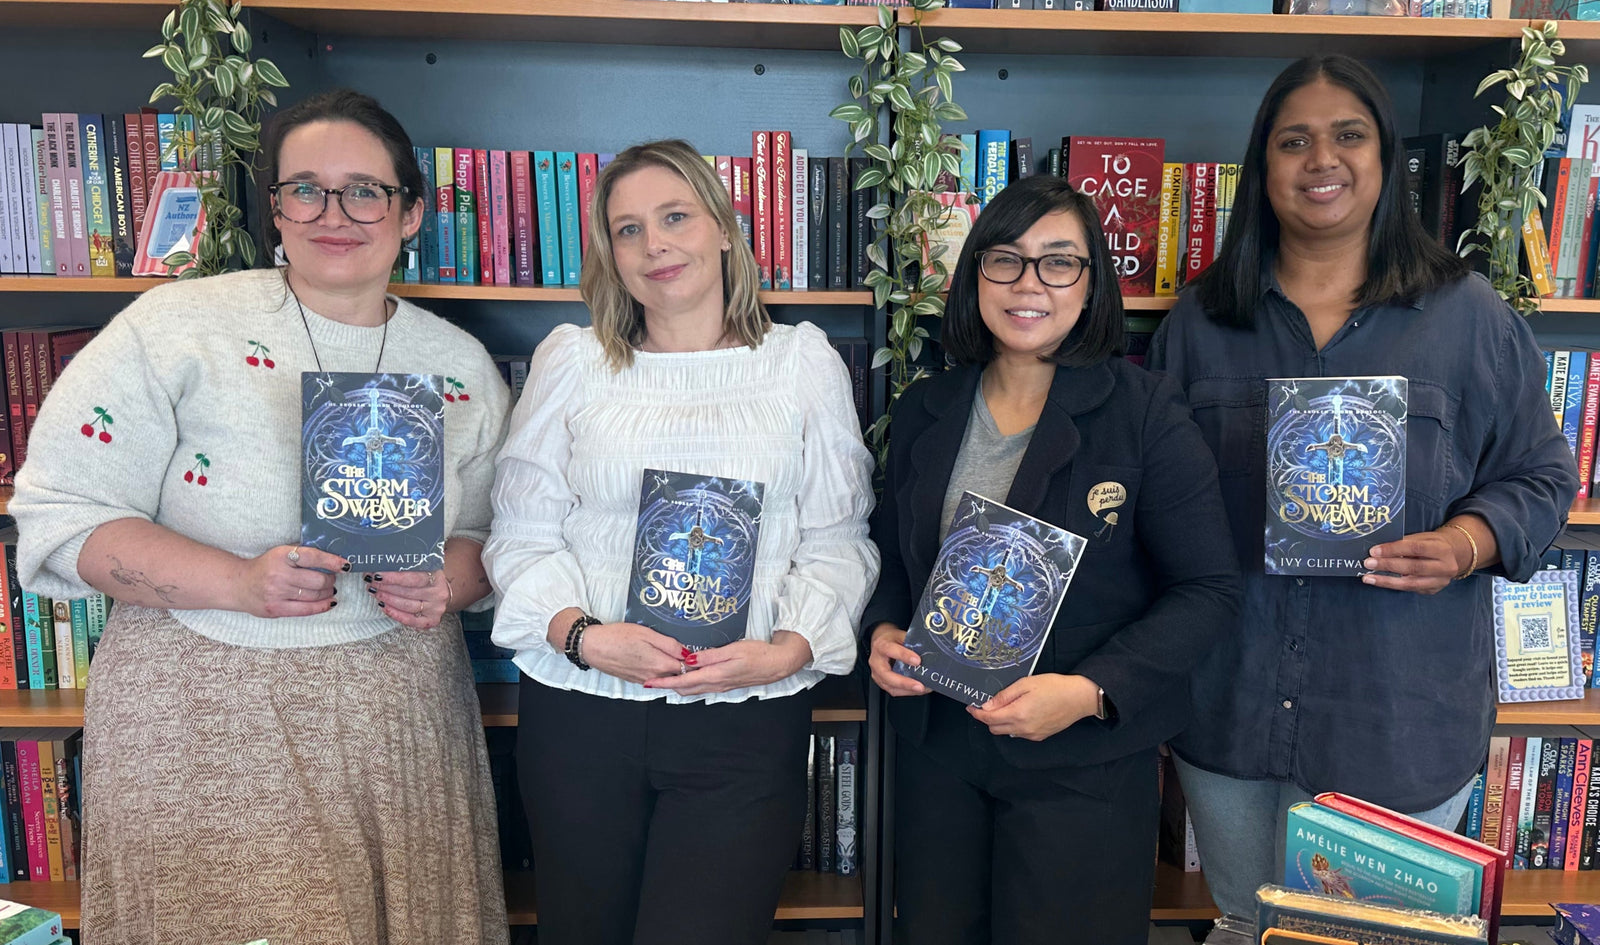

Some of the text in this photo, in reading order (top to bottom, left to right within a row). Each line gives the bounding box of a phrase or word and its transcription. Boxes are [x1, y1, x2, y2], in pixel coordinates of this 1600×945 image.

[144, 124, 158, 174] THE OTHER
[756, 133, 767, 155] Fast
[777, 133, 786, 155] Fast
[987, 141, 998, 175] FERAL
[998, 141, 1007, 160] THE
[1447, 140, 1456, 167] WARS
[36, 139, 48, 195] Wonderland
[86, 124, 104, 225] CATHERINE CHIDGEY
[128, 124, 144, 223] THE OTHER CATHERINE
[457, 154, 470, 192] Happy
[1101, 154, 1131, 175] TO
[47, 122, 65, 239] THE BLACK MONK CHARLOTTE GRIMSHAW
[65, 122, 83, 239] THE BLACK MONK CHARLOTTE GRIMSHAW
[114, 167, 125, 212] AMERICAN
[439, 153, 451, 224] Book Lovers
[542, 173, 550, 200] Between
[796, 156, 805, 223] ADDICTED TO YOU
[1080, 177, 1148, 198] CAGE
[178, 204, 190, 212] NZ
[460, 195, 470, 225] Place
[517, 194, 526, 214] LEAGUE
[1104, 203, 1121, 226] A
[1190, 166, 1206, 270] DEATH'S END
[118, 214, 127, 236] BOYS
[1158, 168, 1173, 270] THE DARK FOREST
[1104, 233, 1141, 251] ILD
[1552, 356, 1567, 413] KATE ATKINSON
[1566, 374, 1580, 409] SILVA
[1580, 358, 1600, 483] JANET EVANOVICH KING'S RANSOM
[338, 465, 366, 478] THE
[1300, 471, 1326, 484] THE
[1091, 485, 1120, 500] je suis
[1099, 494, 1124, 508] perdu
[347, 554, 429, 565] CLIFFWATER
[662, 558, 686, 571] THE
[1280, 558, 1363, 569] IVY CLIFFWA
[957, 589, 980, 607] THE
[1503, 593, 1528, 601] story
[1530, 592, 1538, 600] &
[1514, 584, 1534, 594] part
[95, 594, 103, 614] DEEP
[1522, 600, 1552, 608] review
[1581, 598, 1592, 632] TEMPEST
[1588, 594, 1599, 635] QUANTUM
[74, 602, 86, 669] Heather Morris
[5, 637, 13, 670] RACHEL
[31, 648, 40, 676] DINNER
[930, 672, 994, 702] CLIFFWATE
[1558, 745, 1568, 775] SPARKS
[1567, 742, 1576, 777] NICHOLAS
[31, 762, 39, 791] SHEILA
[841, 766, 852, 811] STEEL GODS
[1474, 773, 1483, 790] ACT
[1509, 762, 1522, 791] TENANT
[1528, 778, 1533, 787] OF
[1571, 744, 1590, 827] Ann Cleeves
[1538, 783, 1546, 812] STORM
[1544, 791, 1552, 812] IRON
[1554, 788, 1562, 824] SHYAMALAN
[1585, 767, 1600, 827] KARLA'S CHOICE
[1471, 808, 1479, 831] WALKER
[1483, 784, 1503, 847] GAMES UNTOLD
[1554, 827, 1562, 853] REMAIN
[1296, 827, 1348, 857] AMÉLIE
[1354, 851, 1387, 874] WEN
[1394, 869, 1439, 894] ZHAO
